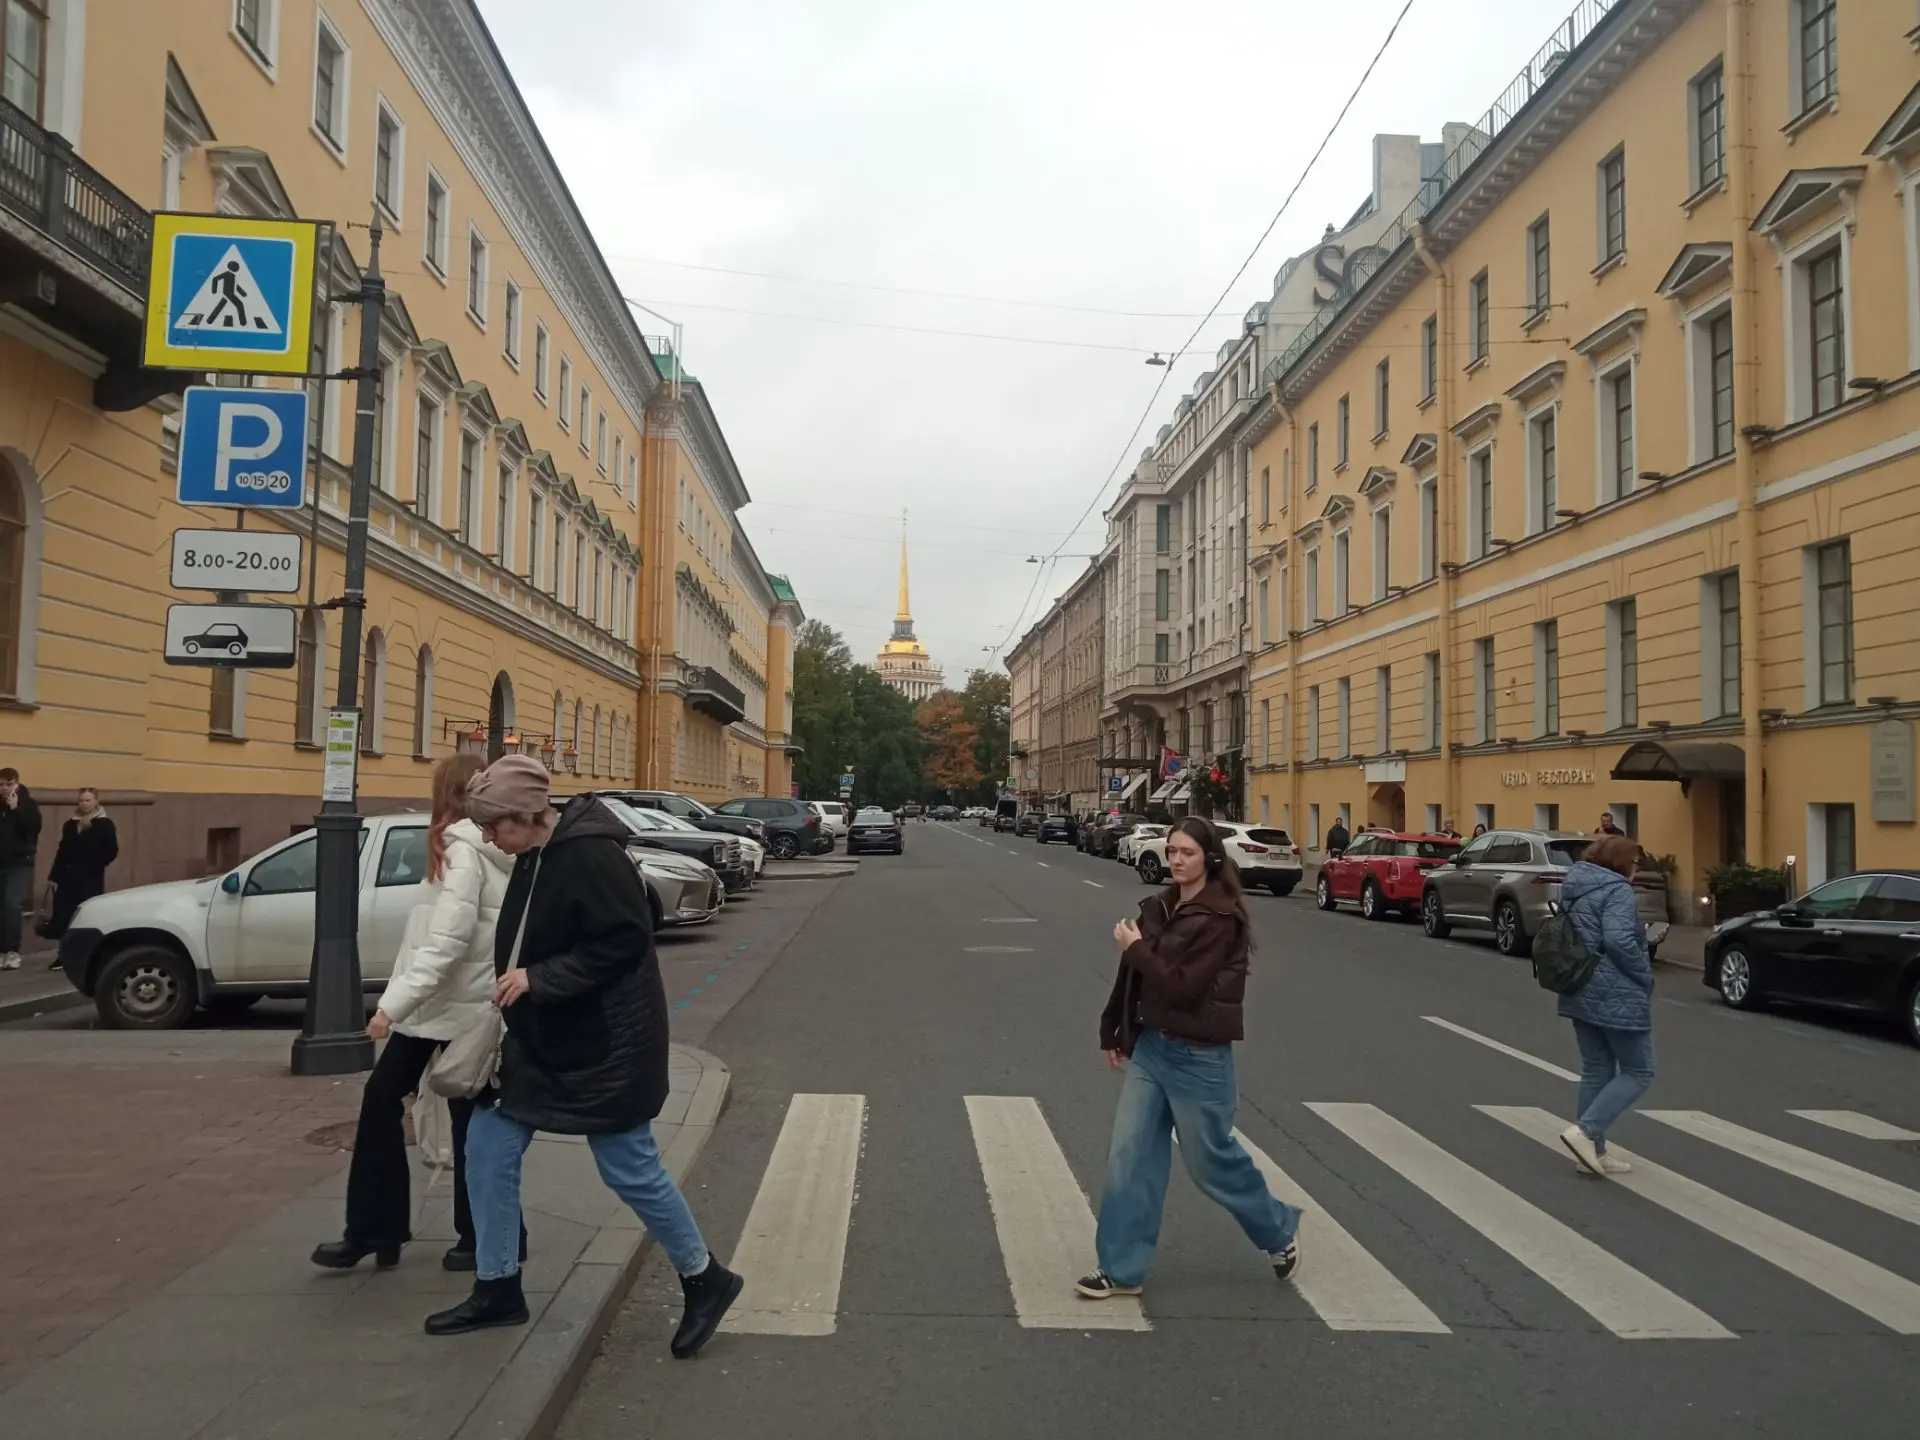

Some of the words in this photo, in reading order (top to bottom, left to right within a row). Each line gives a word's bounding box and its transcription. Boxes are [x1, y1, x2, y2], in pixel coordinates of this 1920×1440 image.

[214, 402, 283, 491] P
[239, 475, 249, 485] 10
[252, 475, 265, 487] 15
[269, 475, 290, 489] 20
[183, 549, 291, 571] 8.00-20.00
[1537, 769, 1595, 786] РЕСТОРАН
